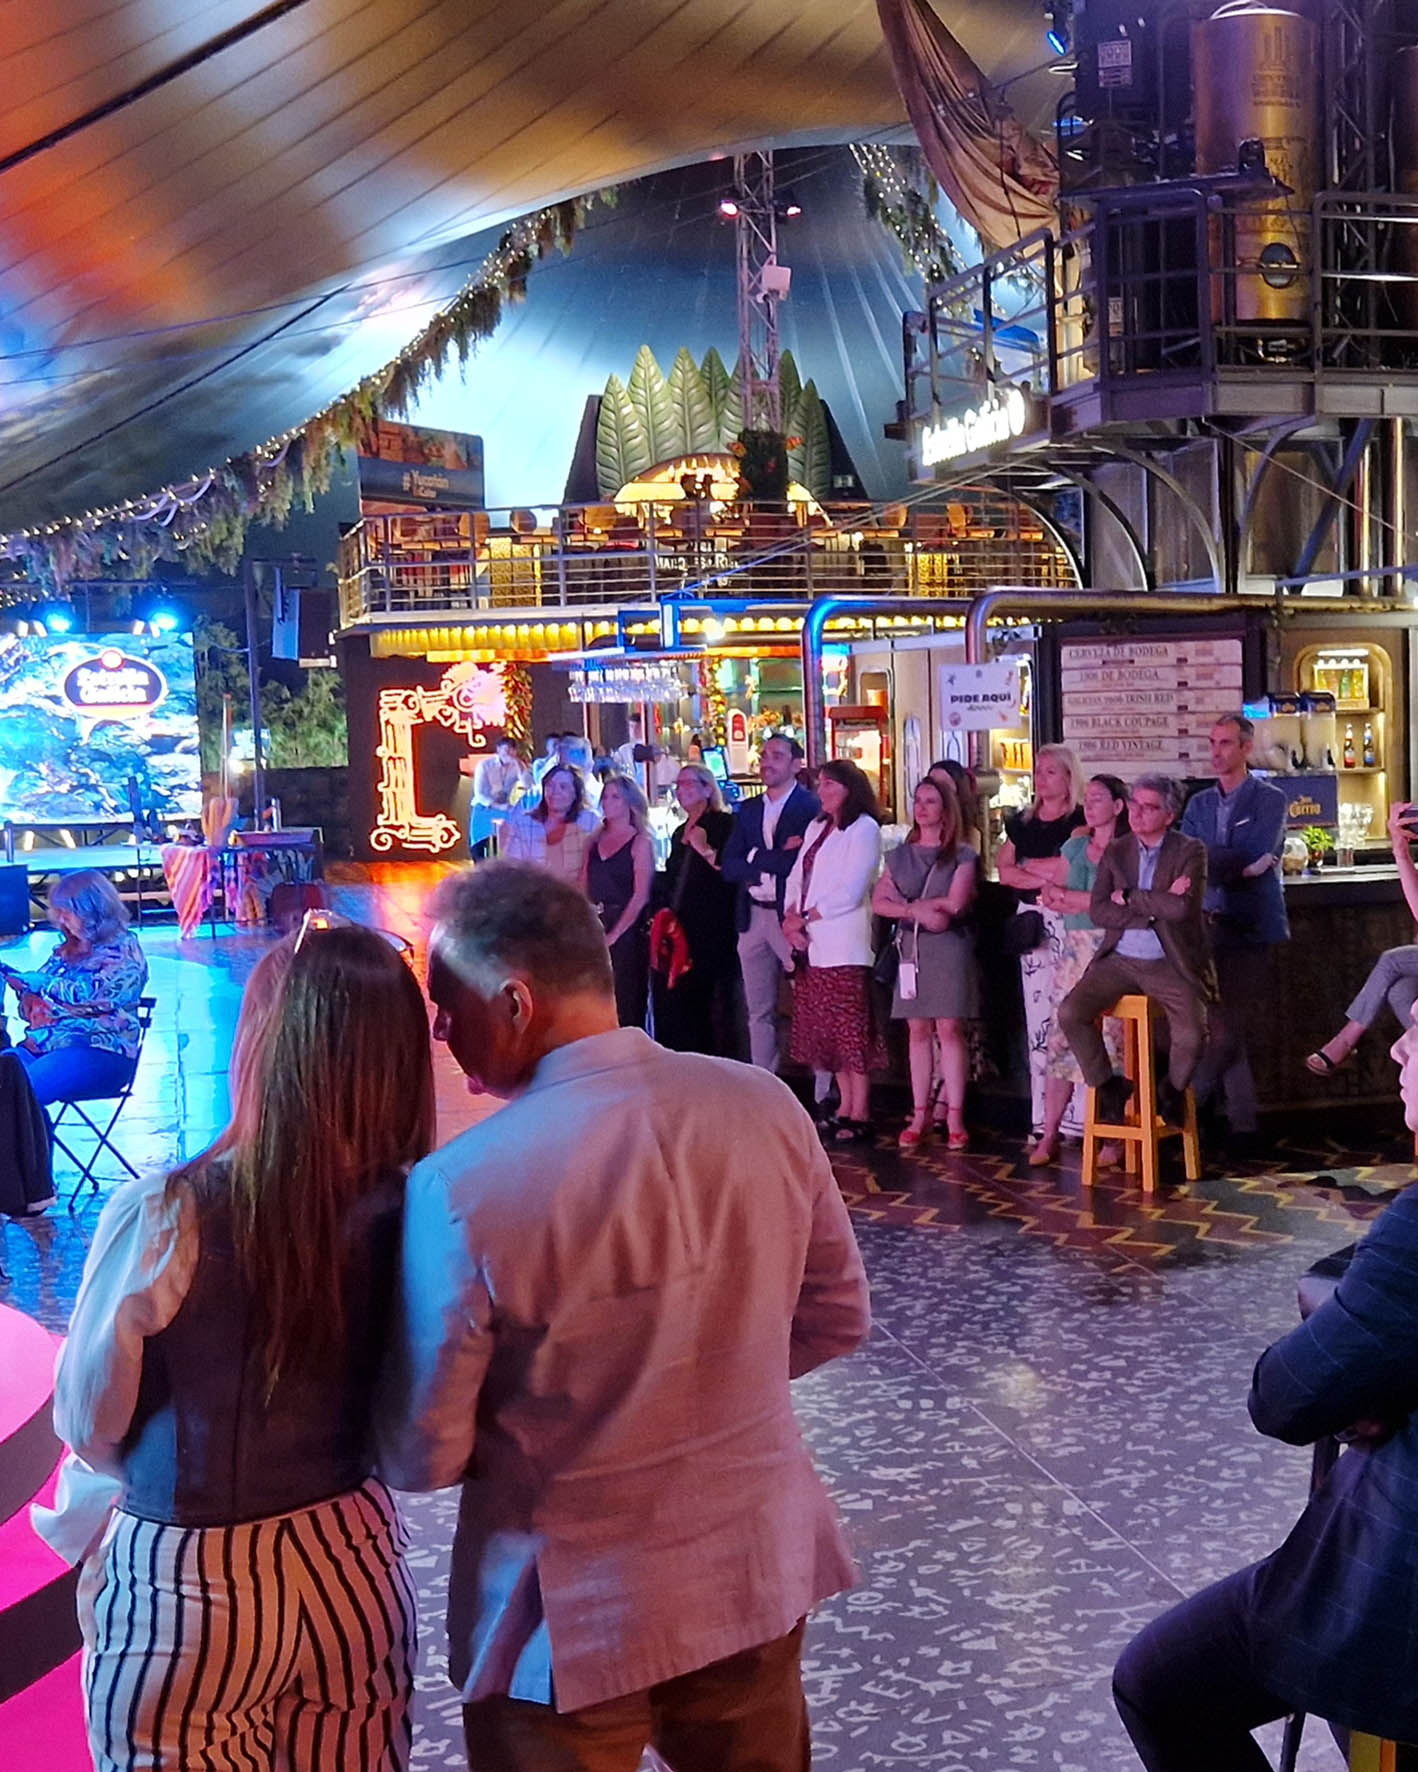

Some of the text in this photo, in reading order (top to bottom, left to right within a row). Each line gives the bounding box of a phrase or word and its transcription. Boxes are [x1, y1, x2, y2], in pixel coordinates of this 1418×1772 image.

[1069, 644, 1169, 659] CERVEZA DE BODEGA
[1102, 671, 1114, 681] DE
[1117, 669, 1160, 681] BODEGA
[950, 695, 979, 704] PIDE
[1091, 717, 1122, 729] BLACK
[1124, 716, 1169, 729] COUPAGE
[1100, 739, 1120, 751] RED
[1121, 739, 1163, 751] VINTAGE
